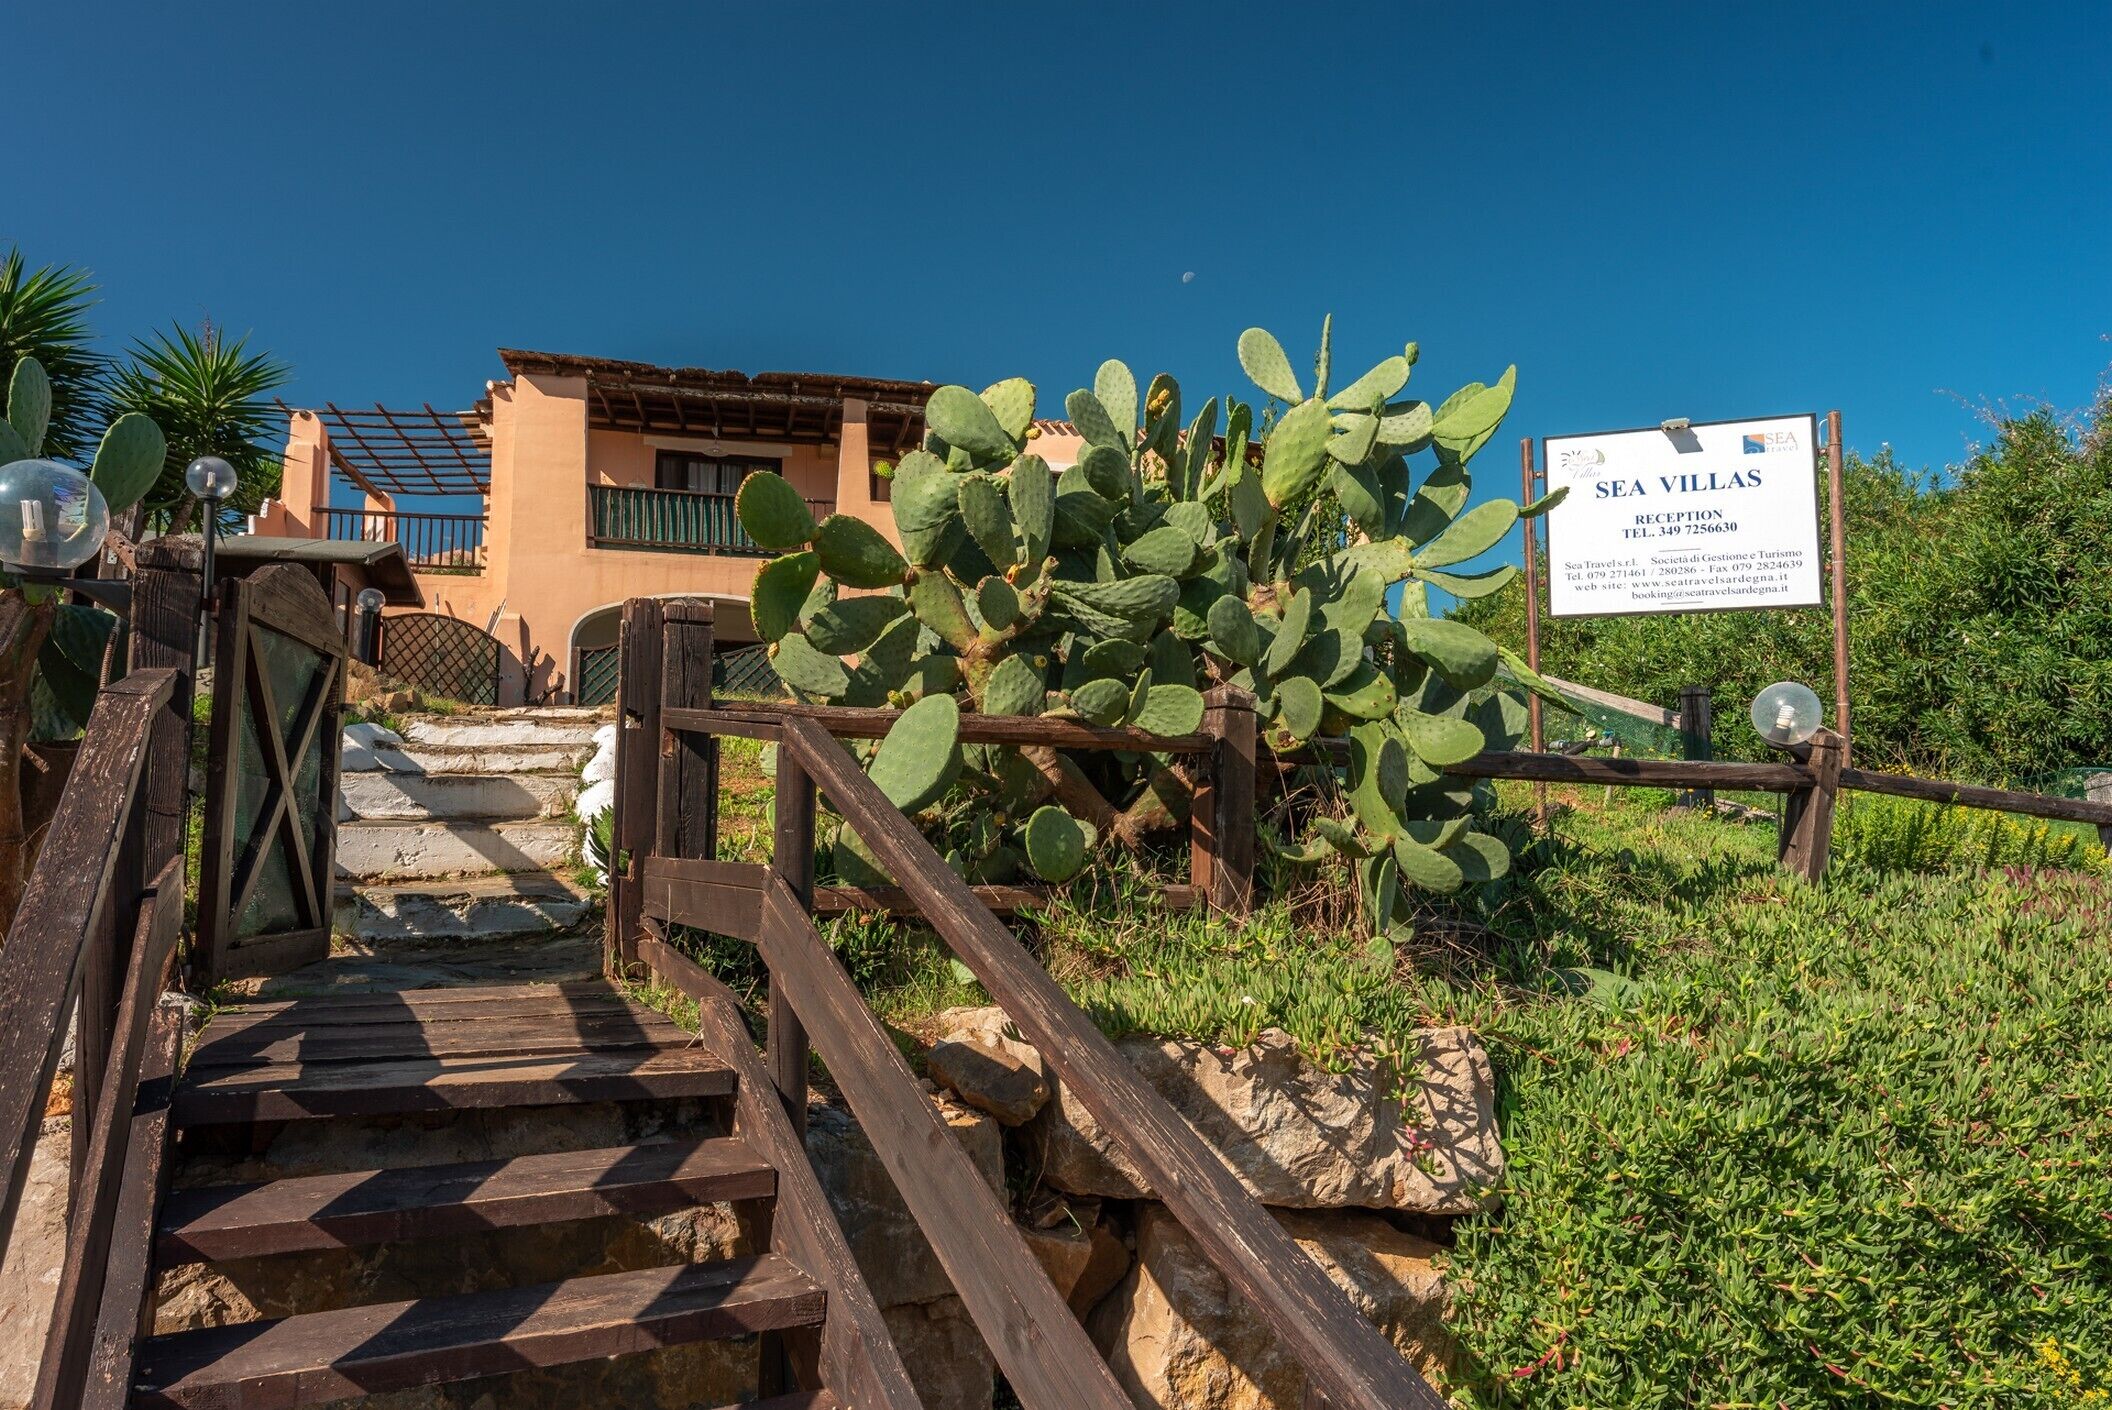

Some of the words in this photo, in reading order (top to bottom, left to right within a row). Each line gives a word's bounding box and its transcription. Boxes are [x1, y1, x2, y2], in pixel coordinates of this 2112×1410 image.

[1765, 432, 1797, 444] SEA
[1766, 441, 1798, 453] travel
[1595, 479, 1646, 499] SEA
[1659, 469, 1762, 493] VILLAS
[1635, 510, 1723, 525] RECEPTION
[1622, 526, 1655, 539] TEL.
[1658, 525, 1681, 537] 349
[1686, 522, 1738, 535] 7256630
[1565, 561, 1583, 570] Sea
[1583, 559, 1615, 569] Travel
[1617, 558, 1638, 567] s.r.l.
[1650, 554, 1688, 565] Società
[1690, 554, 1700, 563] di
[1702, 552, 1748, 562] Gestione
[1757, 549, 1803, 559] Turismo
[1565, 572, 1583, 581] Tel.
[1587, 571, 1606, 580] 079
[1609, 569, 1646, 579] 271461
[1658, 566, 1697, 576] 280286
[1709, 565, 1728, 574] Fax
[1732, 563, 1752, 572] 079
[1756, 560, 1803, 571] 2824639
[1574, 582, 1597, 592] web
[1602, 581, 1627, 590] site:
[1632, 573, 1788, 588] www.seatravelsardegna.it
[1632, 584, 1789, 600] booking@seatravelsardegna.it
